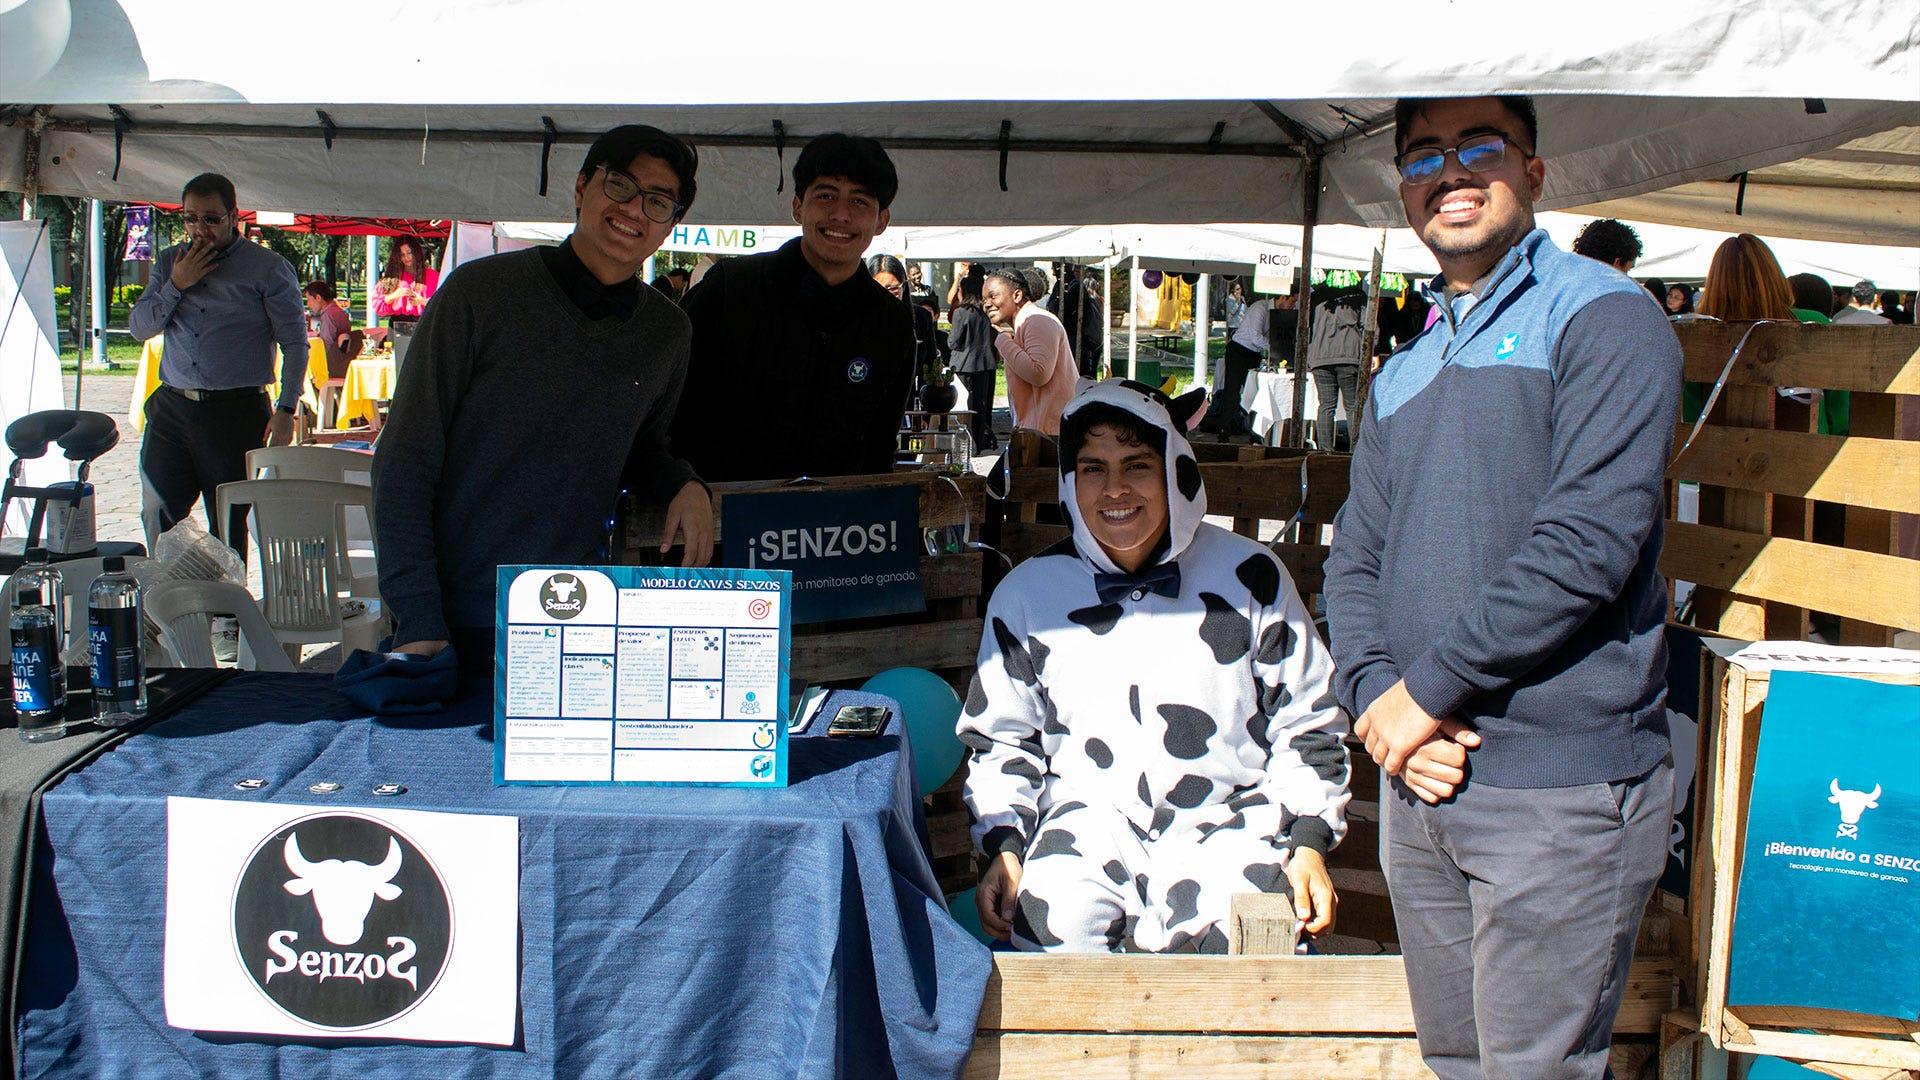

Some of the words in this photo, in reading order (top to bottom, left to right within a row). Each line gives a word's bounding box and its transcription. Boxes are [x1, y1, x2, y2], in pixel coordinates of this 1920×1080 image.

[1260, 253, 1290, 266] RICO
[749, 520, 897, 568] ¡SENZOS!
[640, 577, 686, 589] MODELO
[688, 579, 733, 590] CANVAS
[736, 580, 781, 591] SENZOS
[805, 574, 858, 590] monitoreo
[860, 572, 874, 585] de
[876, 570, 918, 587] ganado.
[1764, 841, 1857, 862] ¡Bienvenido
[1858, 852, 1871, 864] a
[1874, 853, 1920, 872] SENZO
[1834, 867, 1869, 878] monitoreo
[1870, 871, 1880, 879] de
